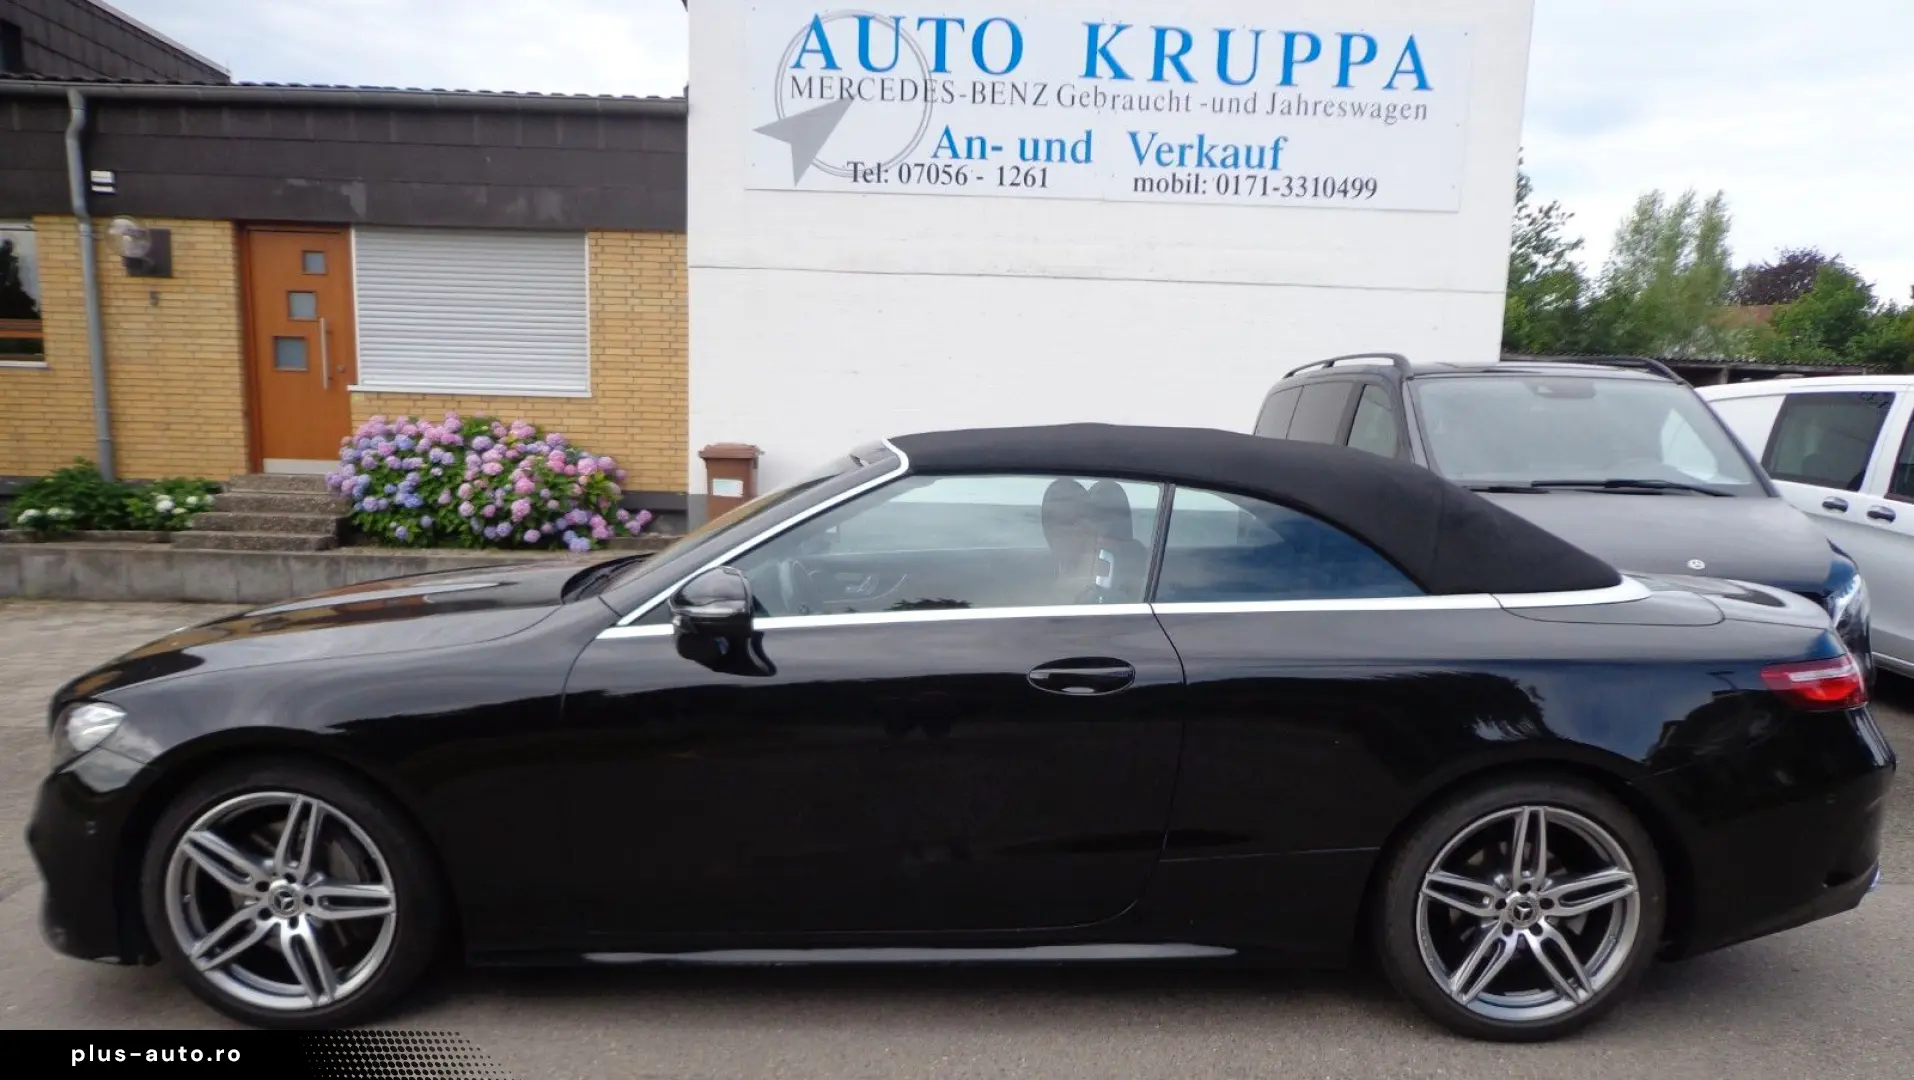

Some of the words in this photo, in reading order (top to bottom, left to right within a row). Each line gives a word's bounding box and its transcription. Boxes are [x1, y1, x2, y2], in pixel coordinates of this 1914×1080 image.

[790, 13, 1024, 76] AUTO
[1079, 21, 1434, 91] KRUPPA
[790, 75, 1049, 107] MERCEDES-BENZ
[1057, 83, 1192, 114] Gebraucht
[1266, 92, 1428, 125] Jahreswagen
[931, 124, 1003, 160] An-
[1018, 129, 1093, 164] und
[1127, 130, 1288, 171] Verkauf
[846, 161, 889, 185] Tel:
[897, 163, 968, 186] 07056
[996, 165, 1049, 189] 1261
[1133, 173, 1207, 195] mobil:
[1216, 173, 1378, 200] 0171-3310499
